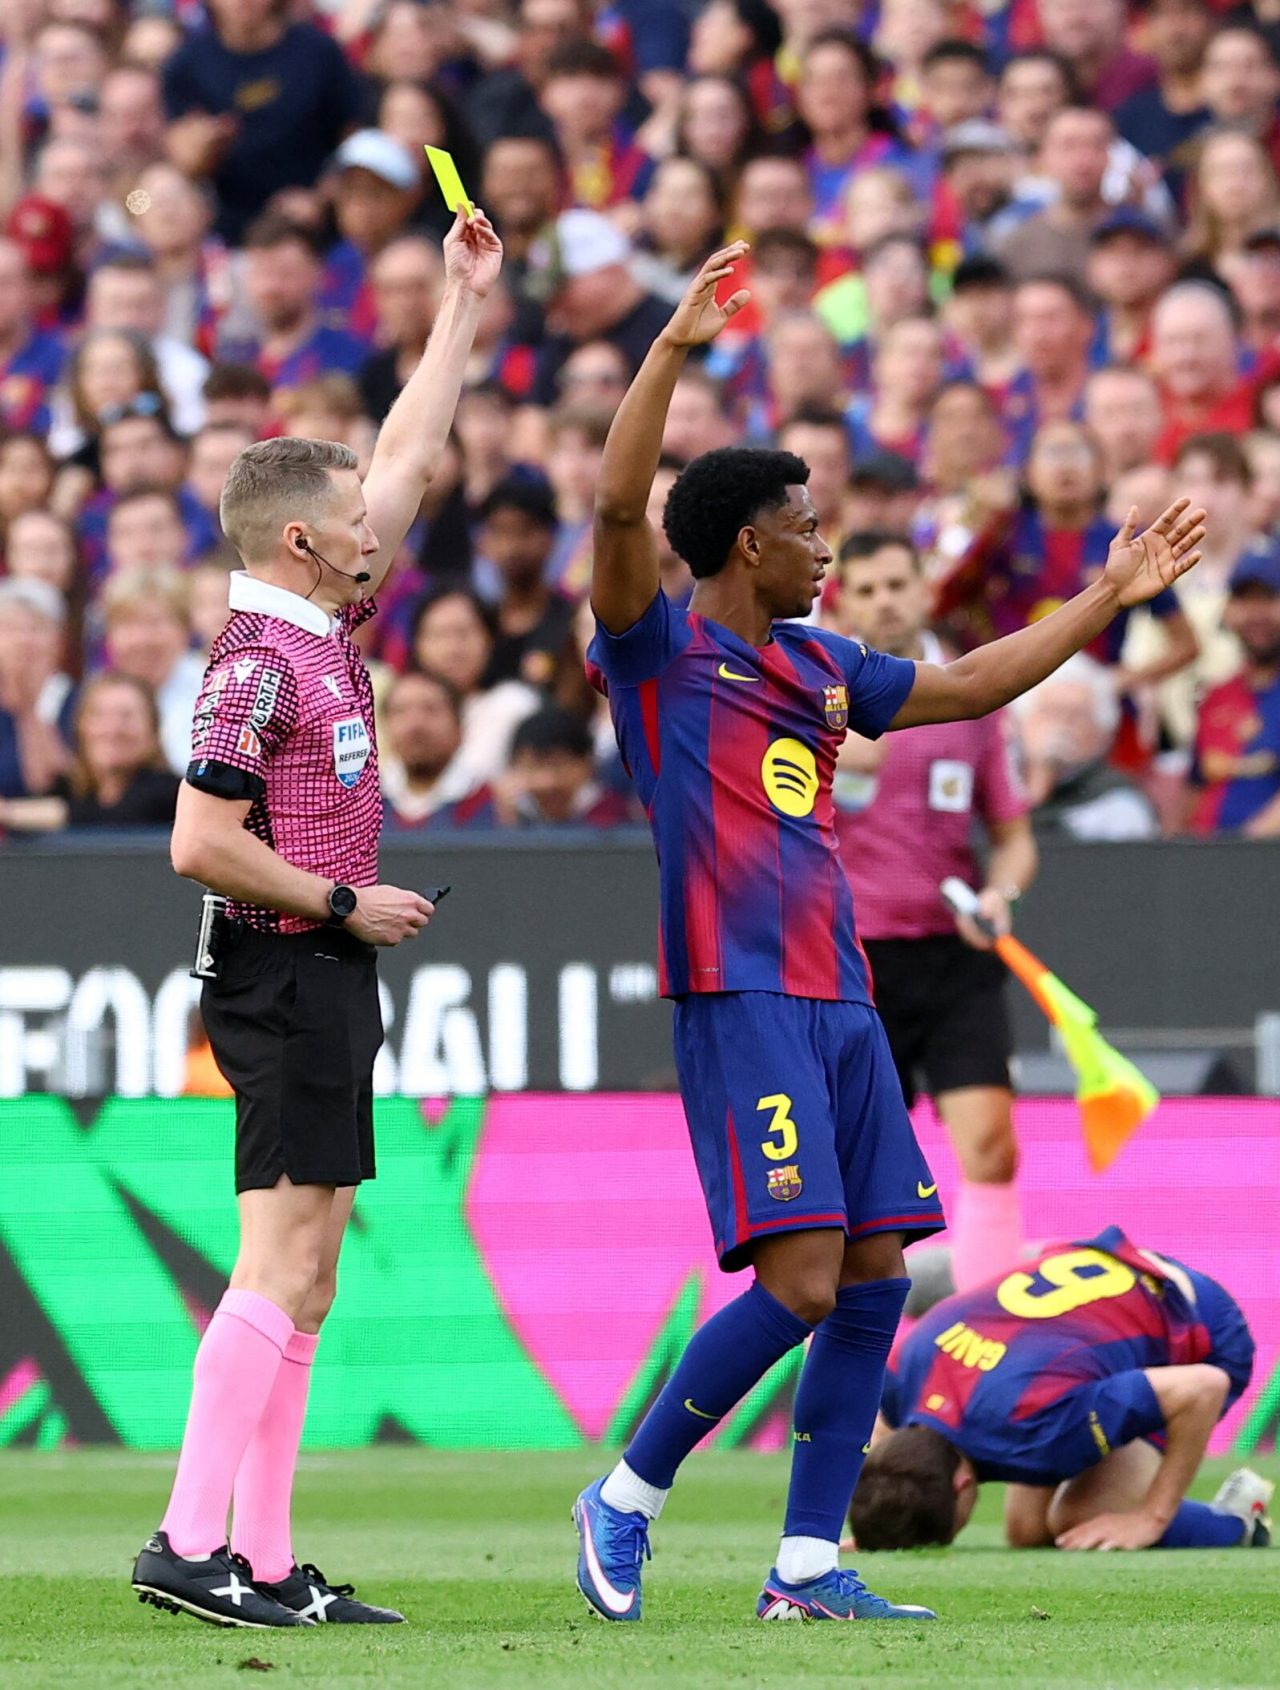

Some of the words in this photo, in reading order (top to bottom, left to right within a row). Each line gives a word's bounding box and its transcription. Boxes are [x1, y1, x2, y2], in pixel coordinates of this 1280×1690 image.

[338, 722, 365, 742] FIFA
[756, 1093, 799, 1161] 3
[934, 1321, 1007, 1372] GAVI
